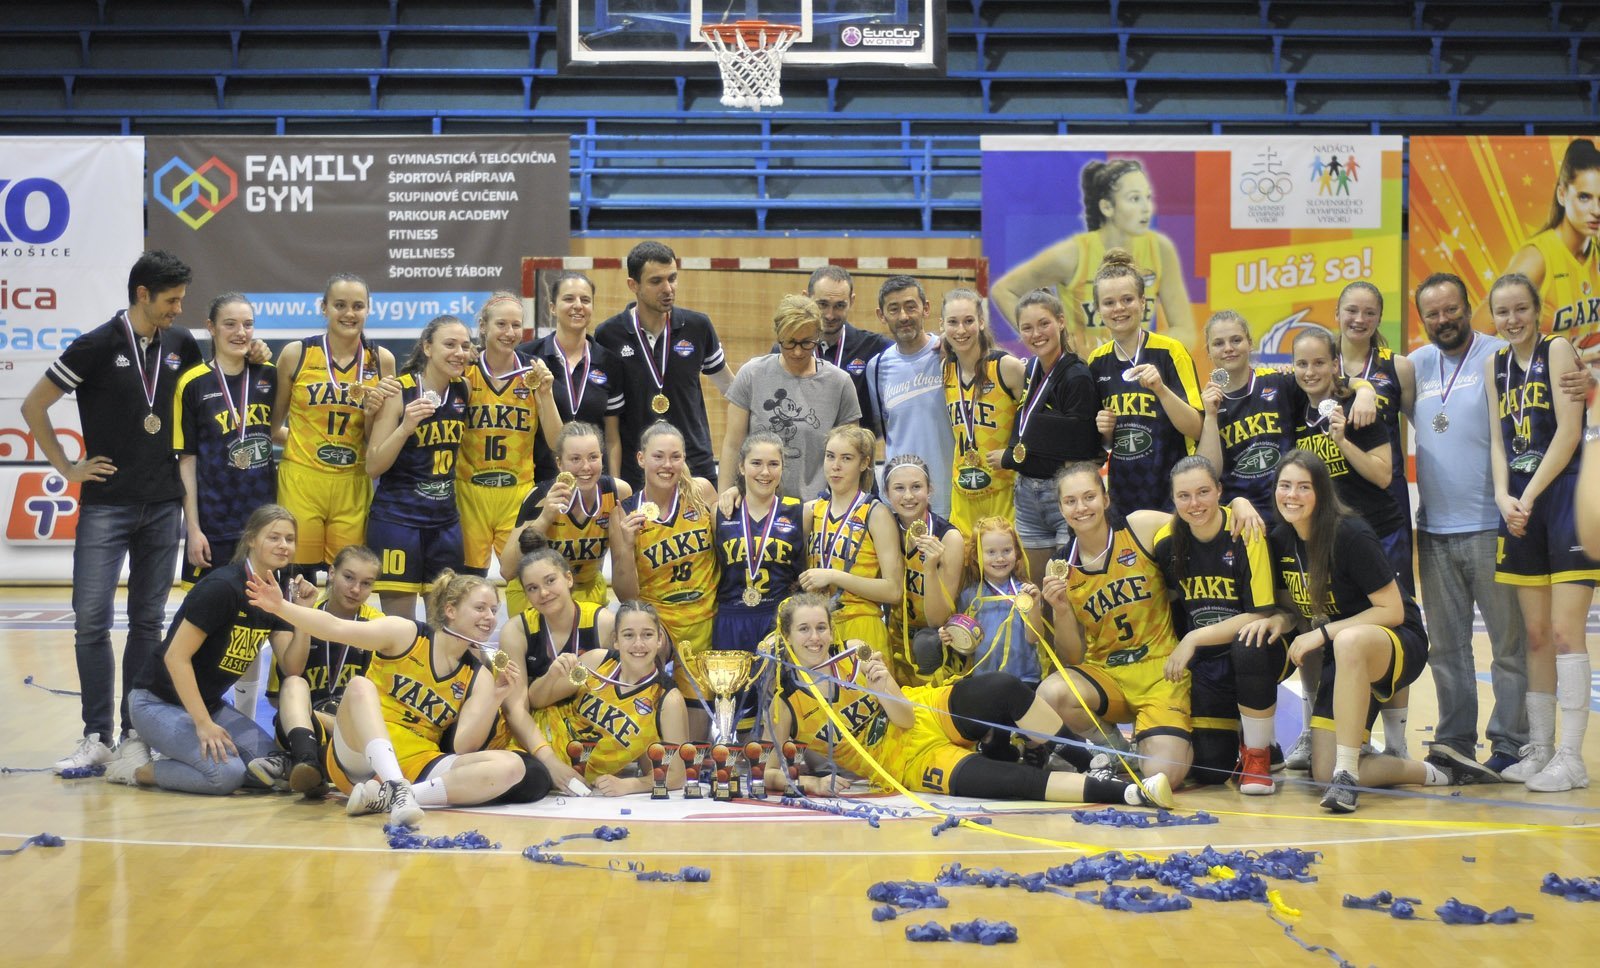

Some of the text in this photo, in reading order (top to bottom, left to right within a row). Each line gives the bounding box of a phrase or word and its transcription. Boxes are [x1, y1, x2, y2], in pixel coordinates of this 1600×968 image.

[862, 28, 920, 38] EuroCup
[246, 155, 374, 181] FAMILY
[388, 151, 556, 165] GYMNASTICKÁ TELOCVIČNA
[388, 170, 515, 183] ŠPORTOVÁ PRÍPRAVA
[246, 186, 313, 212] GYM
[388, 188, 519, 202] SKUPINOVÉ CVIČENIA
[389, 209, 509, 221] PARKOUR ACADEMY
[389, 229, 438, 240] FITNESS
[1, 245, 71, 257] KOŠICE
[389, 248, 455, 259] WELLNESS
[389, 265, 503, 278] ŠPORTOVÉ TÁBORY
[1236, 248, 1372, 293] Ukáž sa!
[1082, 298, 1155, 327] YE
[306, 382, 364, 409] YAK
[1104, 393, 1157, 418] AKE
[327, 411, 351, 436] 17
[467, 405, 531, 432] YAKE
[1219, 412, 1282, 449] YAKE
[485, 435, 507, 461] 16
[433, 450, 453, 475] 10
[643, 528, 711, 569] YAKE
[723, 537, 793, 565] YAKE
[382, 549, 406, 575] 10
[669, 561, 693, 583] 18
[1083, 576, 1151, 623] YAKE
[1179, 576, 1238, 600] YAKE
[1114, 613, 1134, 641] 5
[388, 674, 458, 728] YAKE
[578, 693, 640, 748] YAKE
[815, 694, 880, 748] YKE
[922, 766, 944, 791] 15
